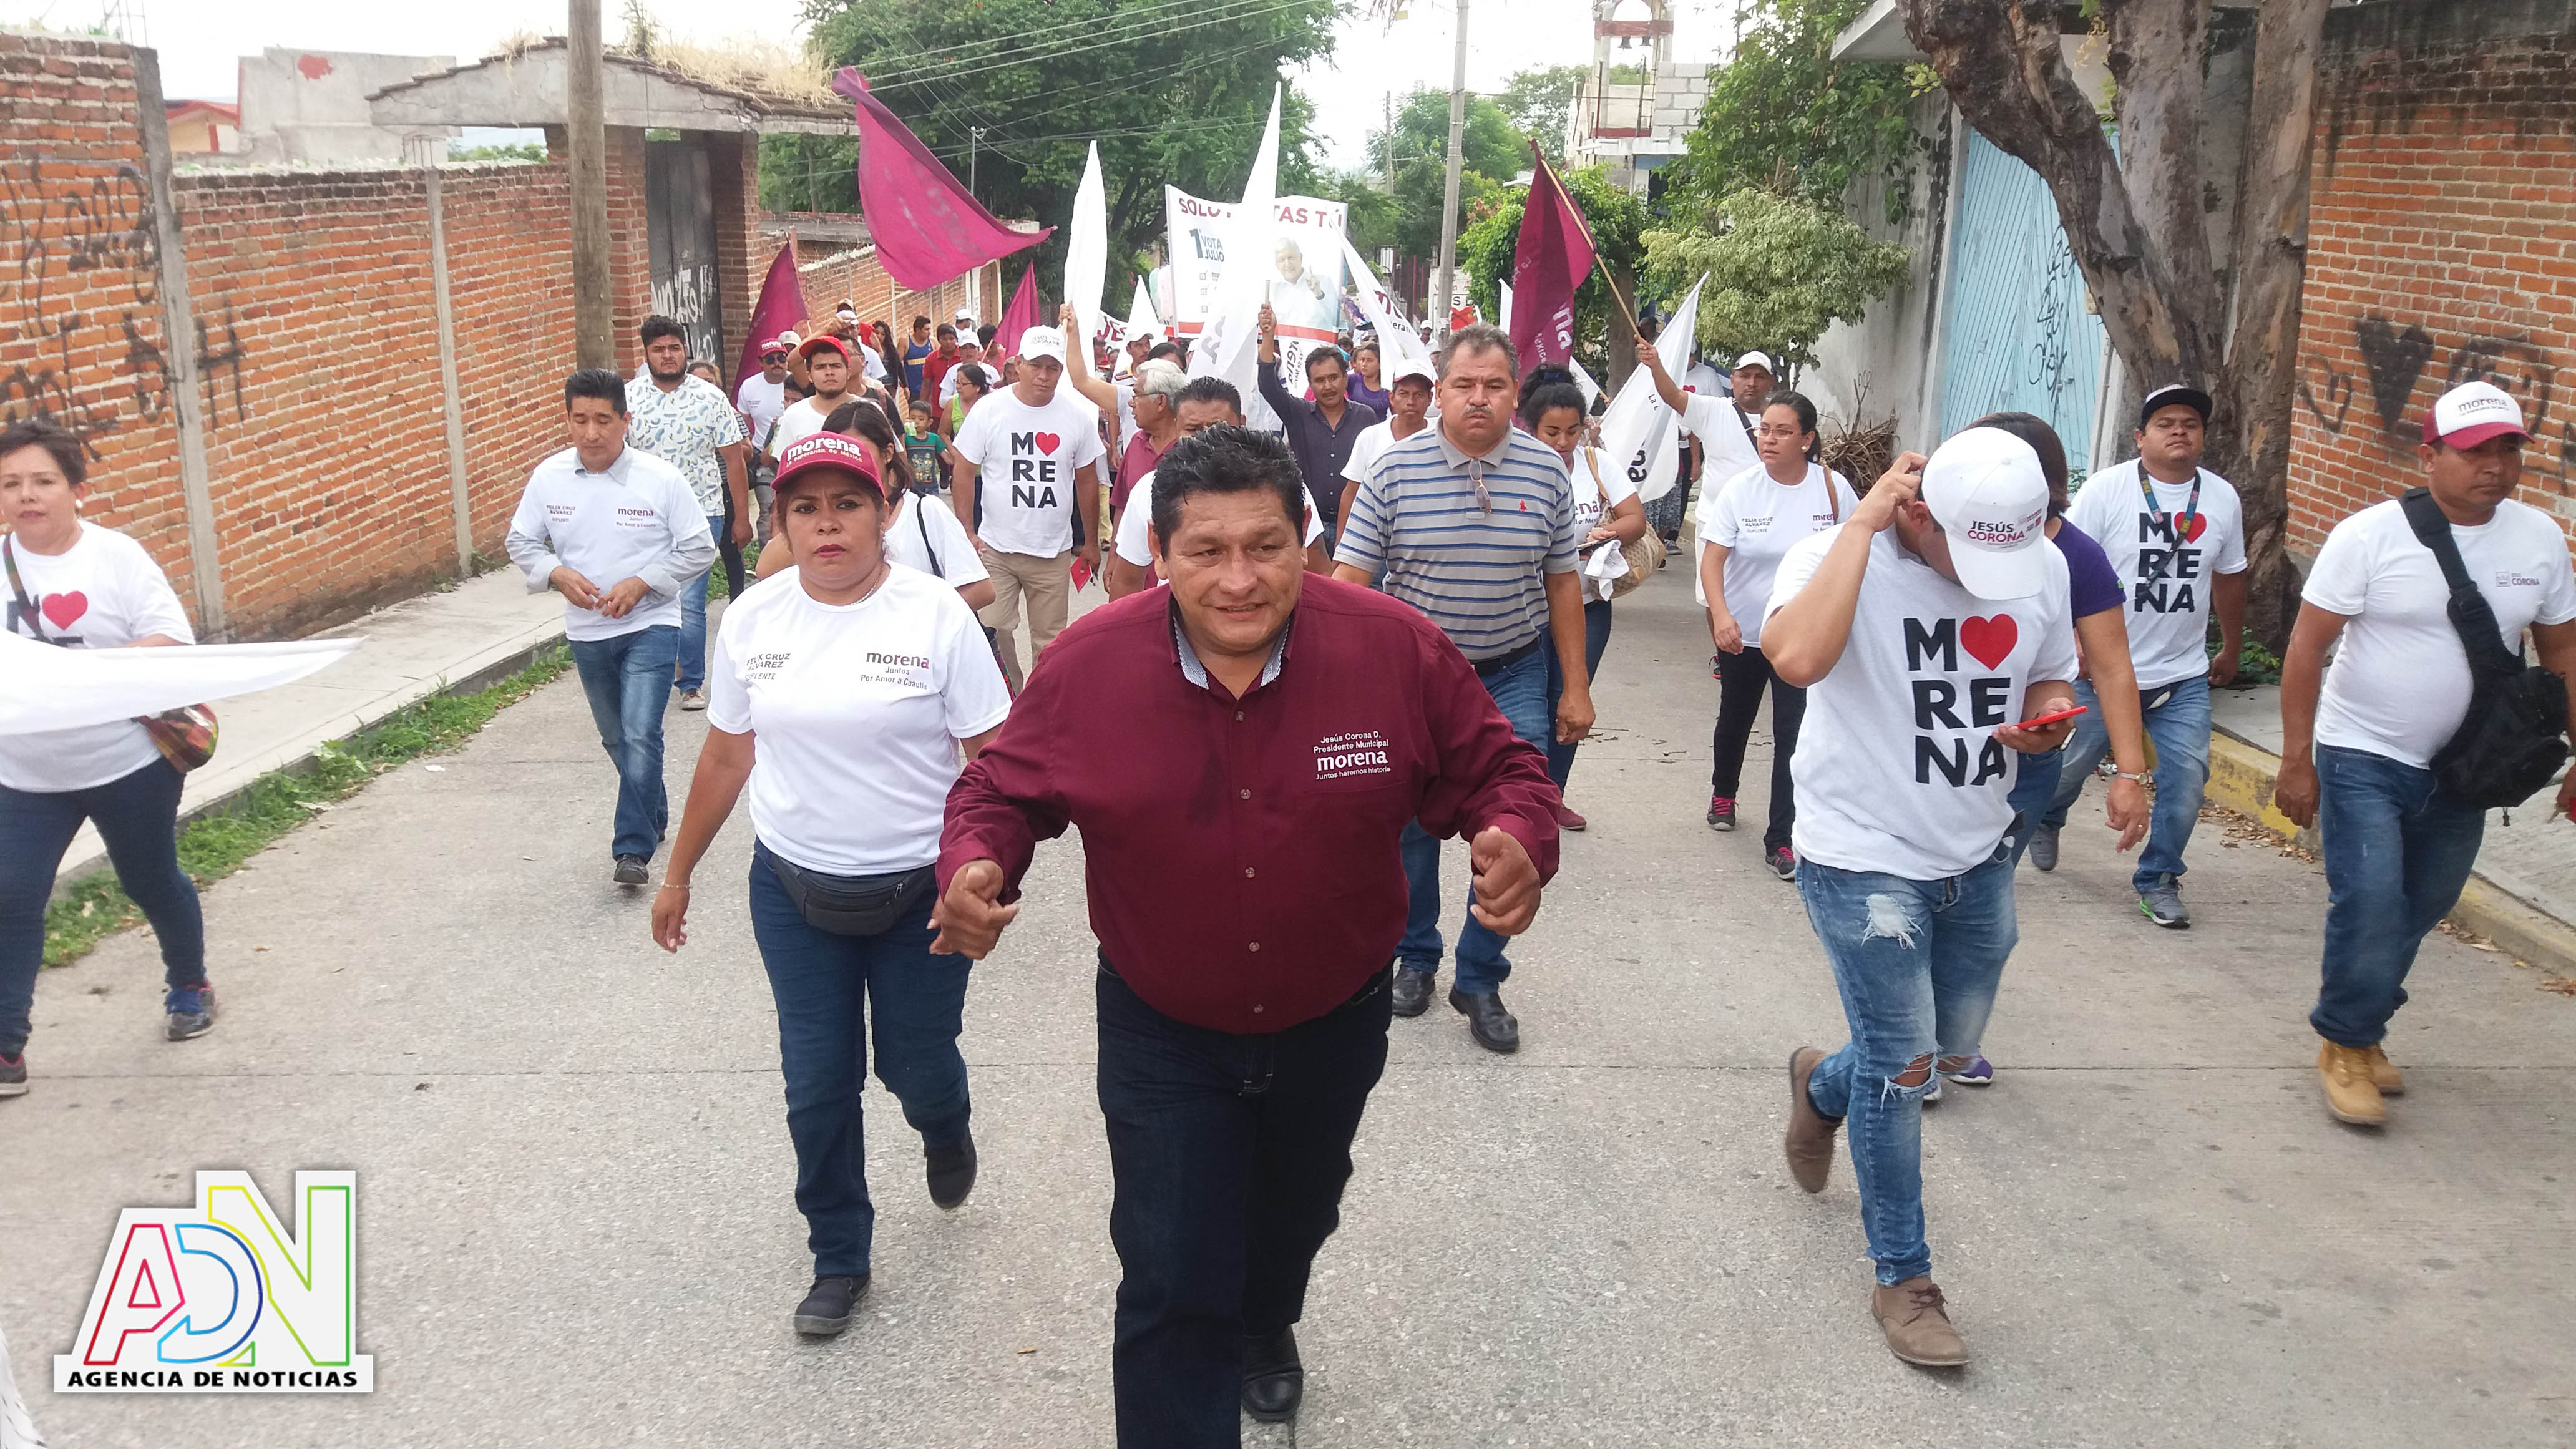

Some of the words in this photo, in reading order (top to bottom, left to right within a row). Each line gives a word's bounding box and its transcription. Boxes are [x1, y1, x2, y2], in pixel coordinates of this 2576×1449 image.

[1201, 235, 1223, 250] VOTA
[1205, 248, 1224, 262] JULIO
[2458, 398, 2507, 412] morena
[787, 437, 861, 462] morena
[793, 448, 826, 462] esperanza
[1013, 459, 1056, 482] RE
[1012, 485, 1057, 509] NA
[618, 508, 654, 517] morena
[1970, 520, 2014, 533] JESÚS
[1967, 530, 2025, 542] CORONA
[2138, 549, 2202, 578] RE
[2134, 583, 2195, 613] NA
[866, 652, 930, 669] morena
[885, 666, 910, 675] Juntos
[875, 675, 895, 683] Amor
[903, 678, 927, 690] Cuautla
[1912, 677, 2011, 730] RE
[1320, 733, 1344, 744] Jesús
[1345, 733, 1372, 741] Corona
[1313, 742, 1354, 754] Presidente
[1355, 739, 1389, 749] Municipal
[1317, 751, 1388, 771] morena
[1915, 735, 2007, 788] NA
[1315, 772, 1339, 780] Juntos
[1339, 768, 1367, 777] haremos
